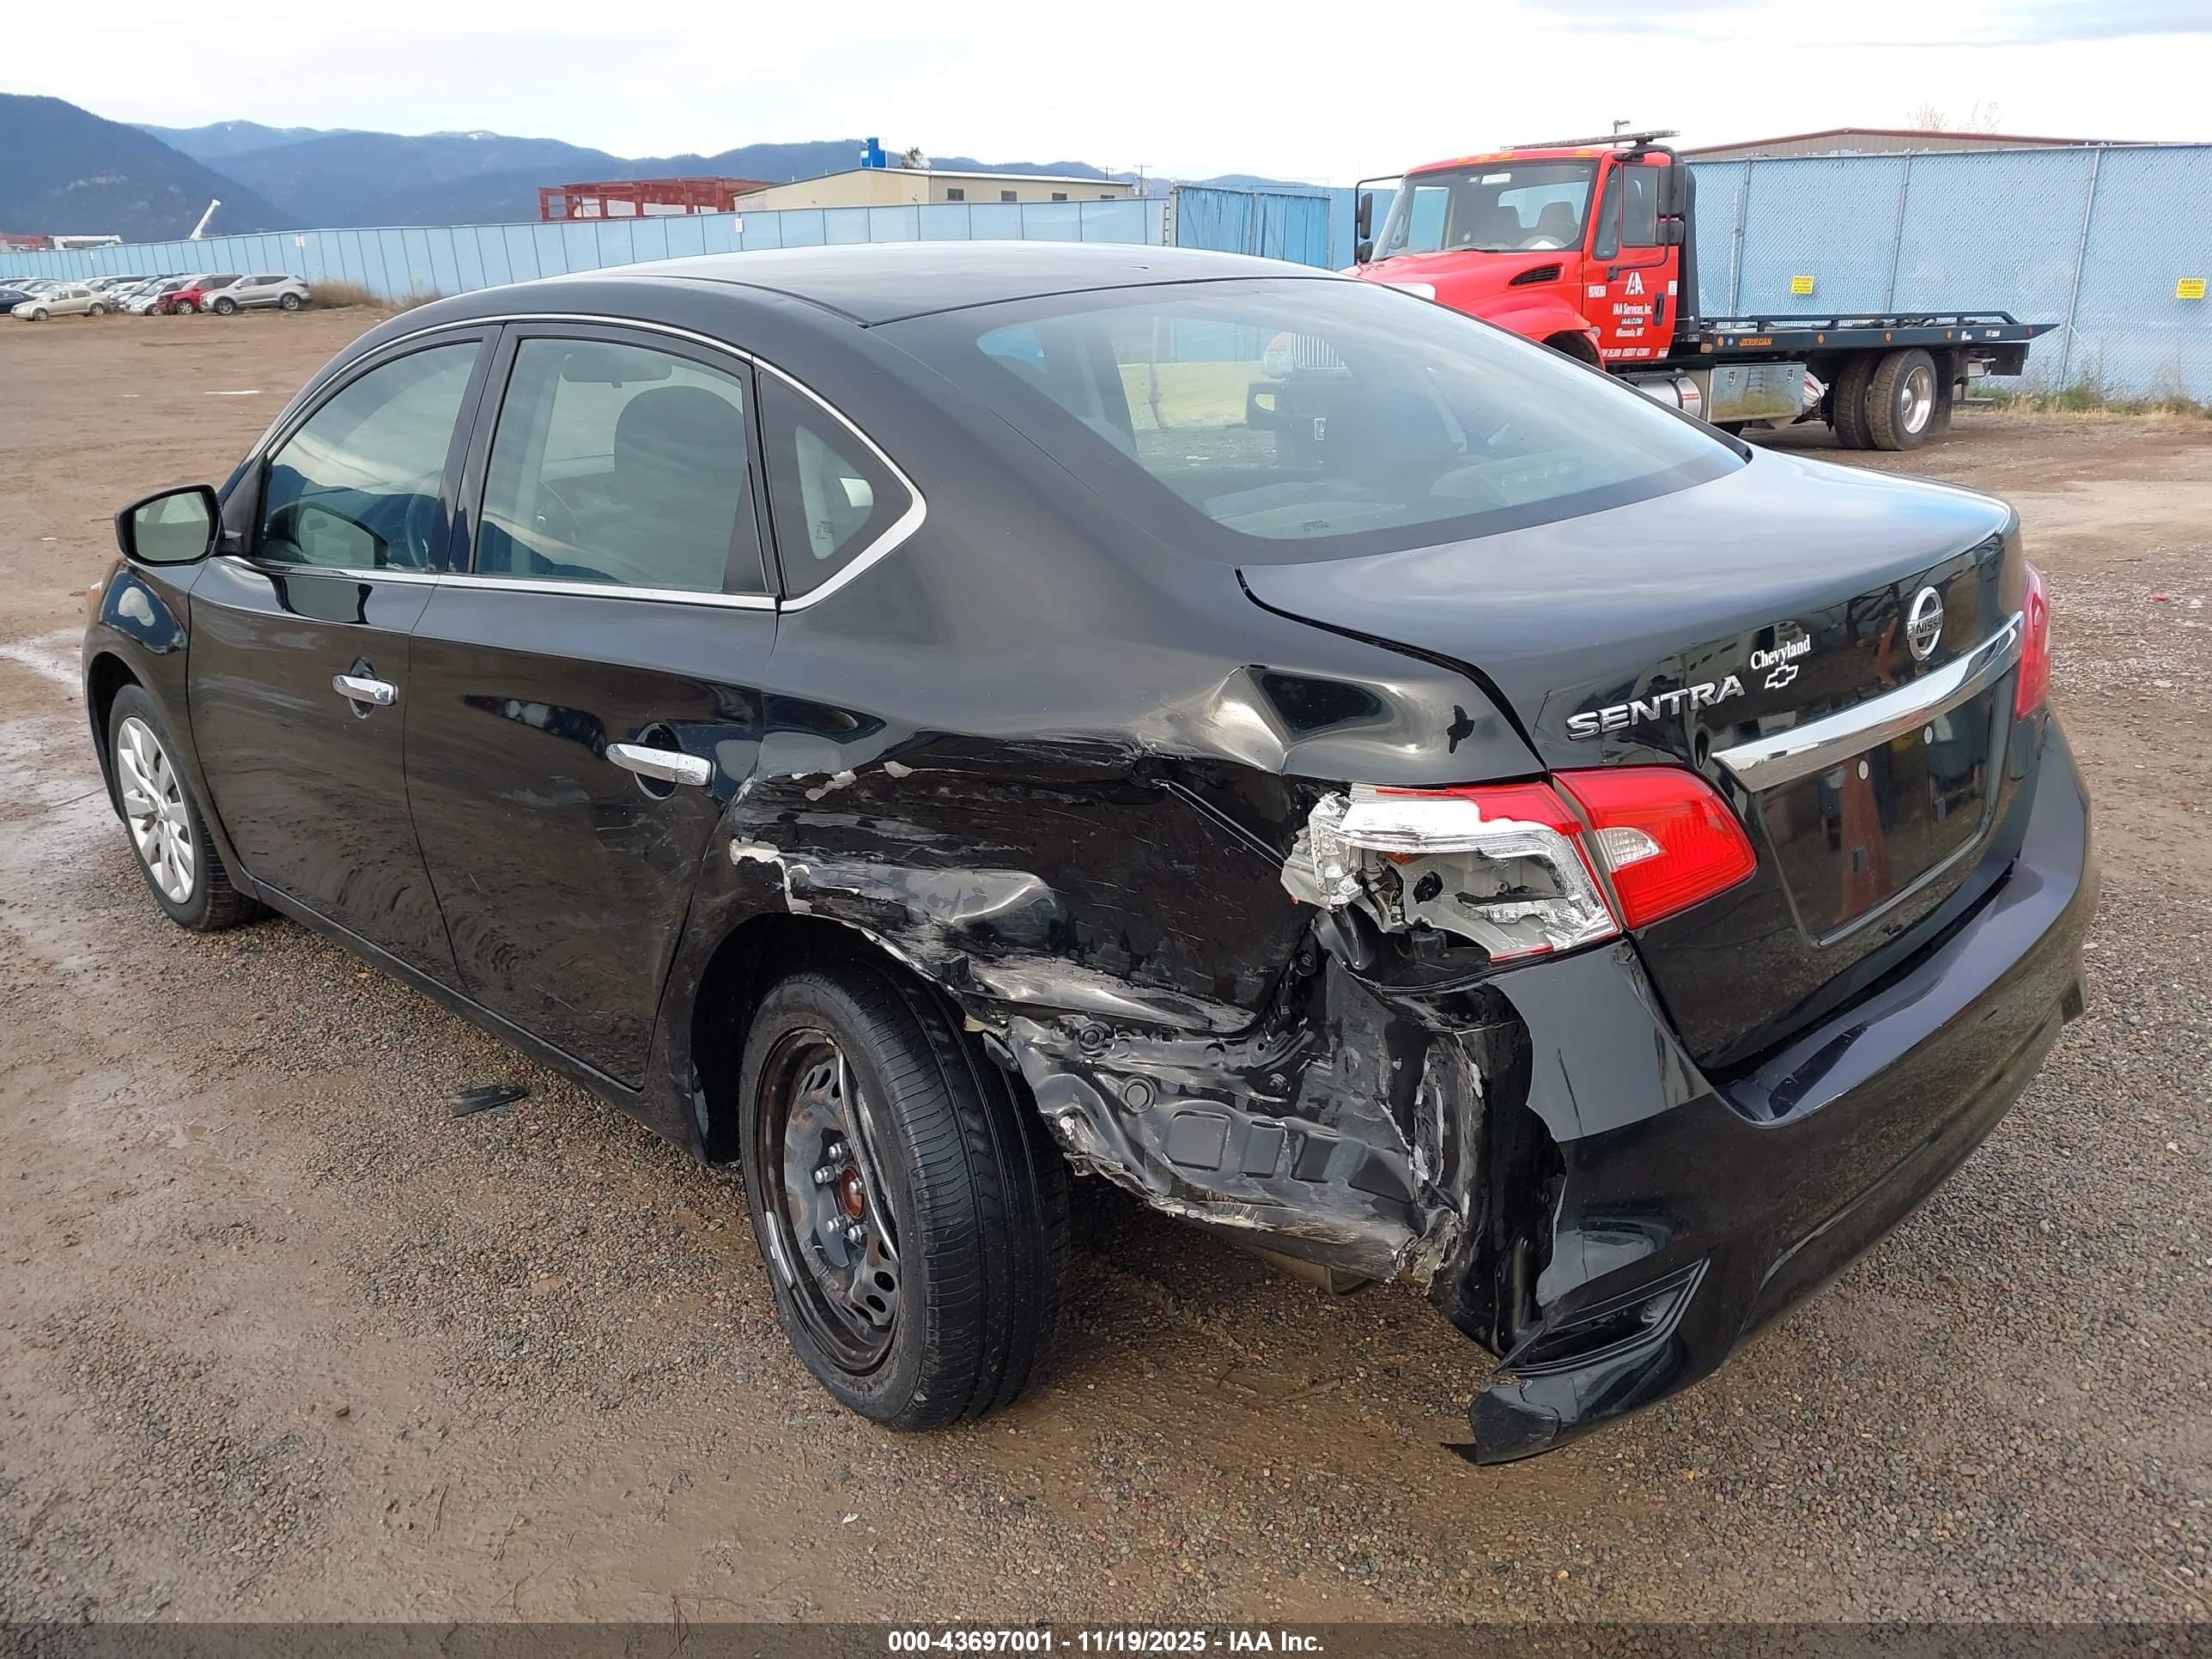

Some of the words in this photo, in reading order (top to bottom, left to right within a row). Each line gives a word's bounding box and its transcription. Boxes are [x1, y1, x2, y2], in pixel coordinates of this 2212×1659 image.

[1613, 302, 1623, 315] IAA
[1750, 634, 1811, 670] Chevyland
[1565, 674, 1746, 741] SENTRA
